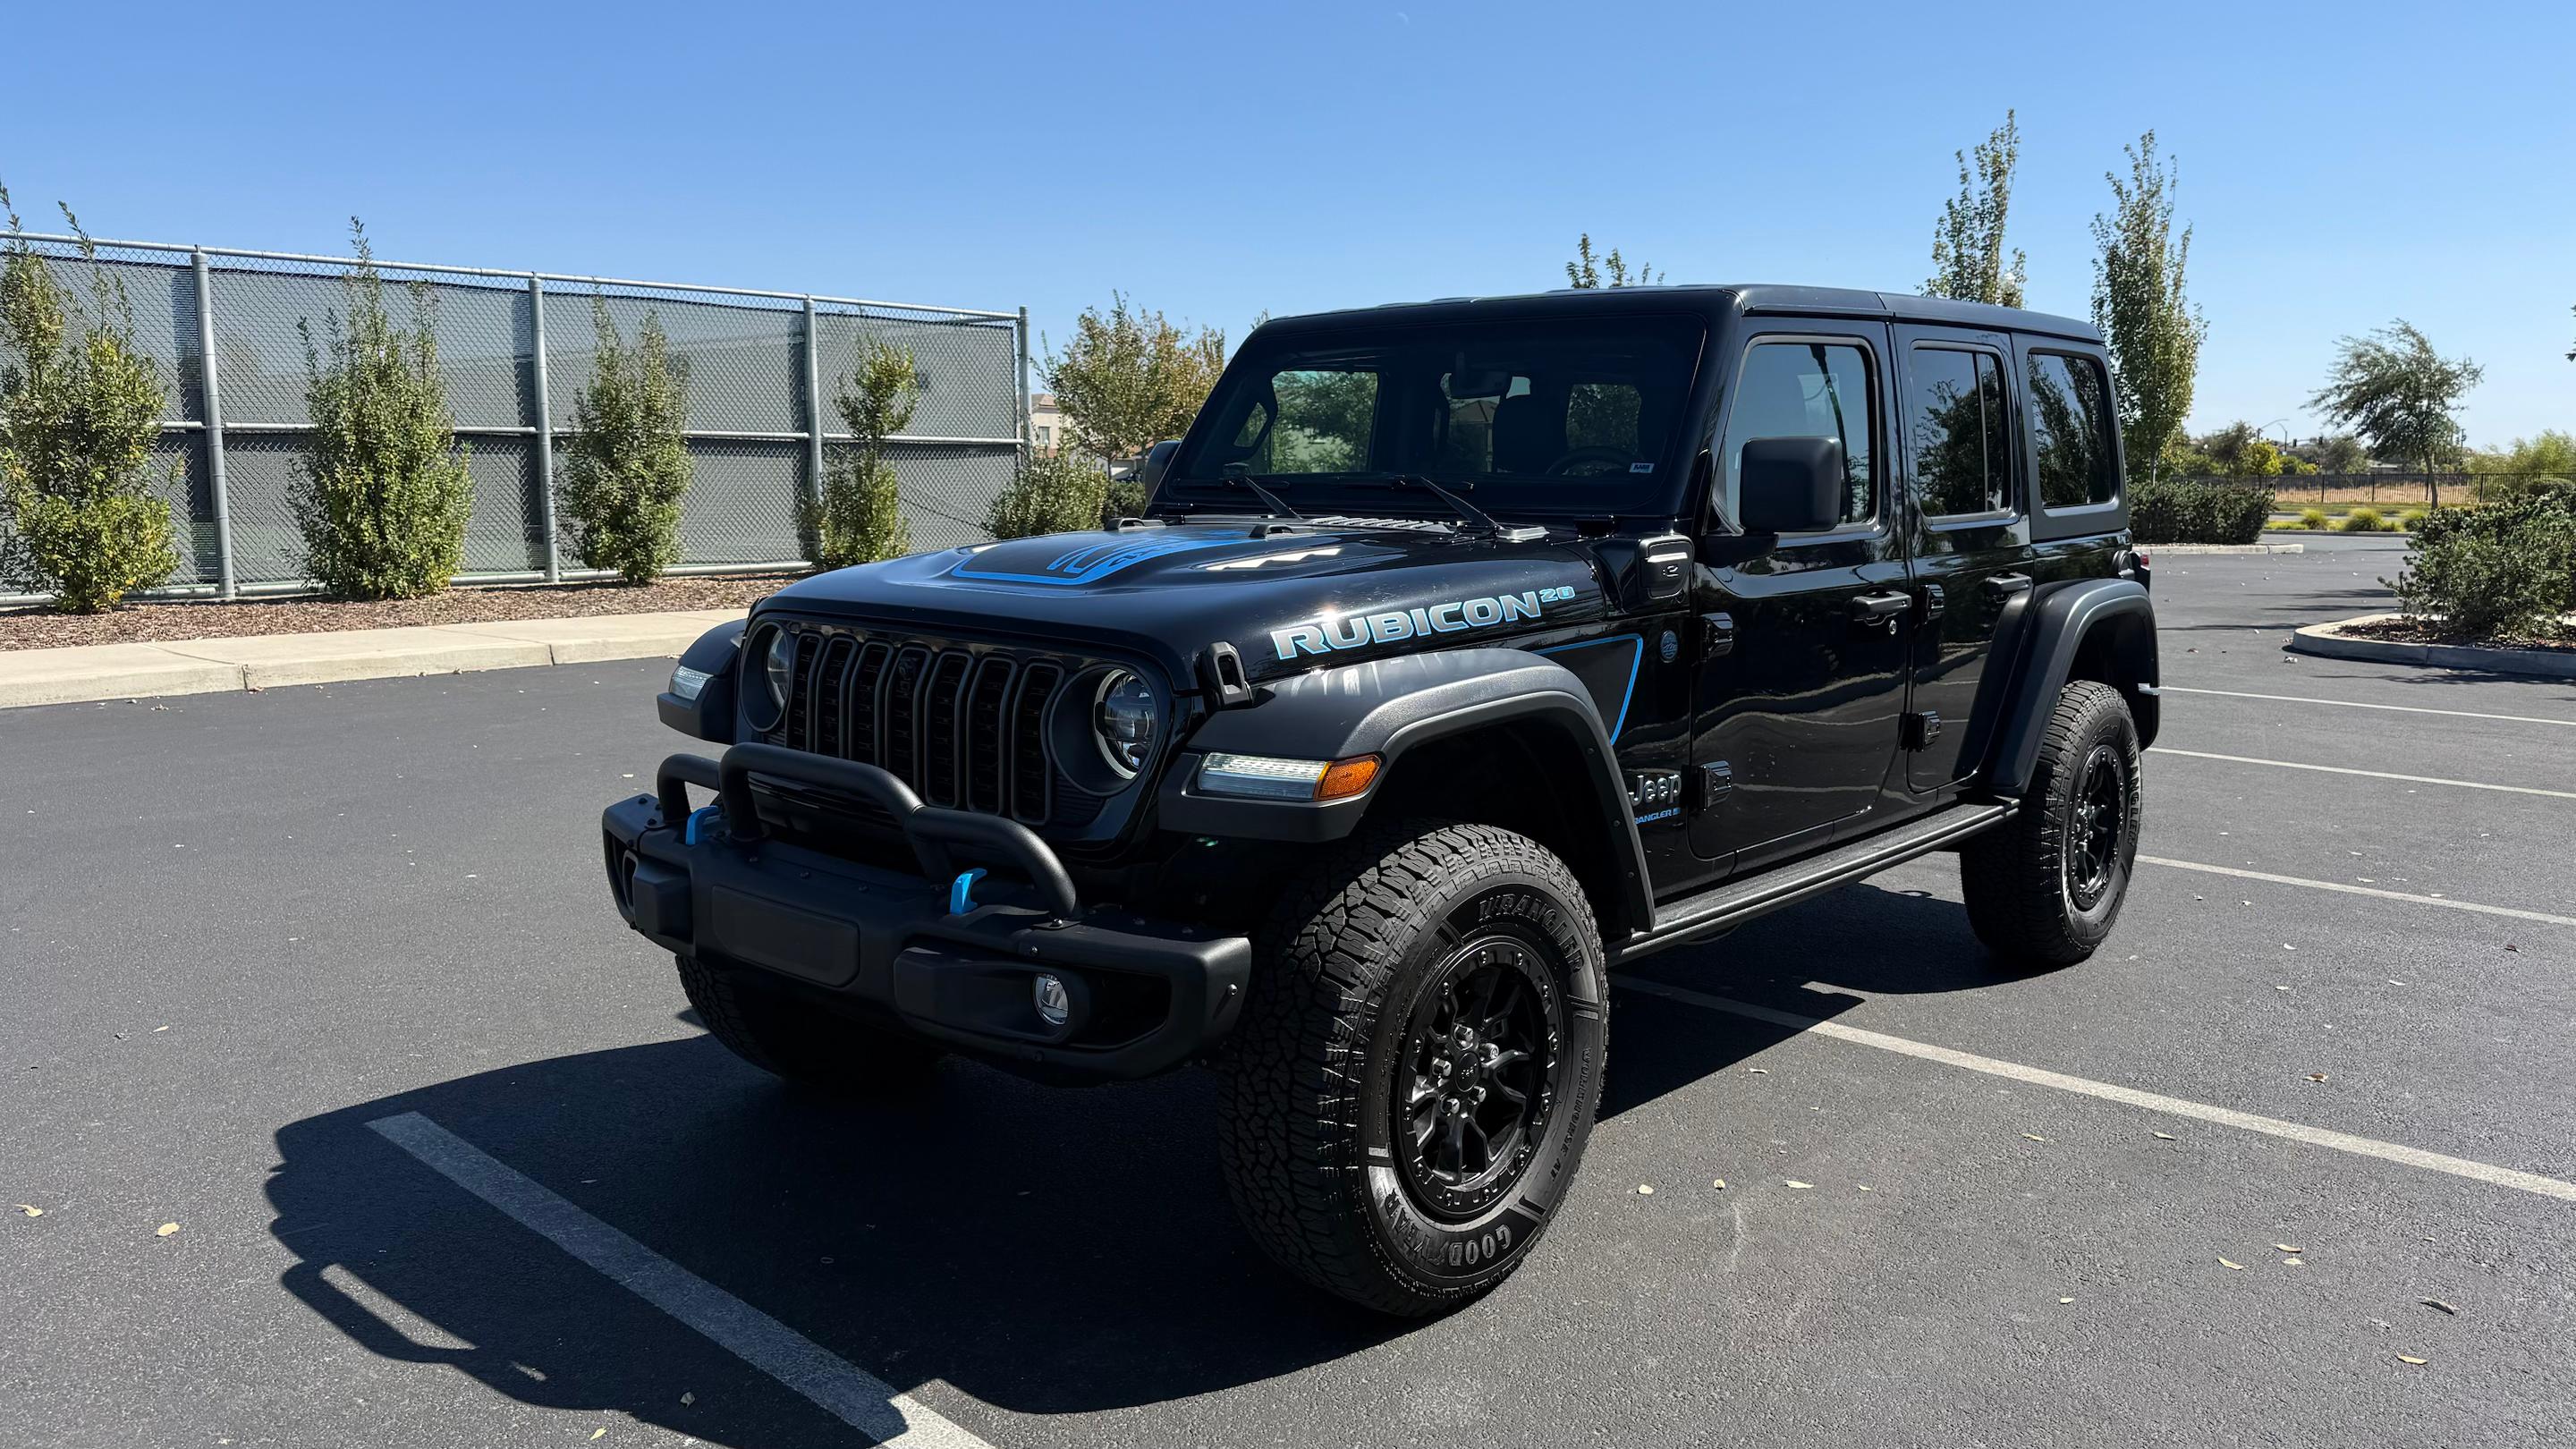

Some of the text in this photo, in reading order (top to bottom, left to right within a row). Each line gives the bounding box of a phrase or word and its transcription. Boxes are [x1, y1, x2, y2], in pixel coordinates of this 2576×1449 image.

[1269, 590, 1542, 660] RUBICON
[1628, 775, 1682, 806] Jeep
[1634, 809, 1672, 825] RANGLER
[1479, 894, 1585, 974] WRANGLER
